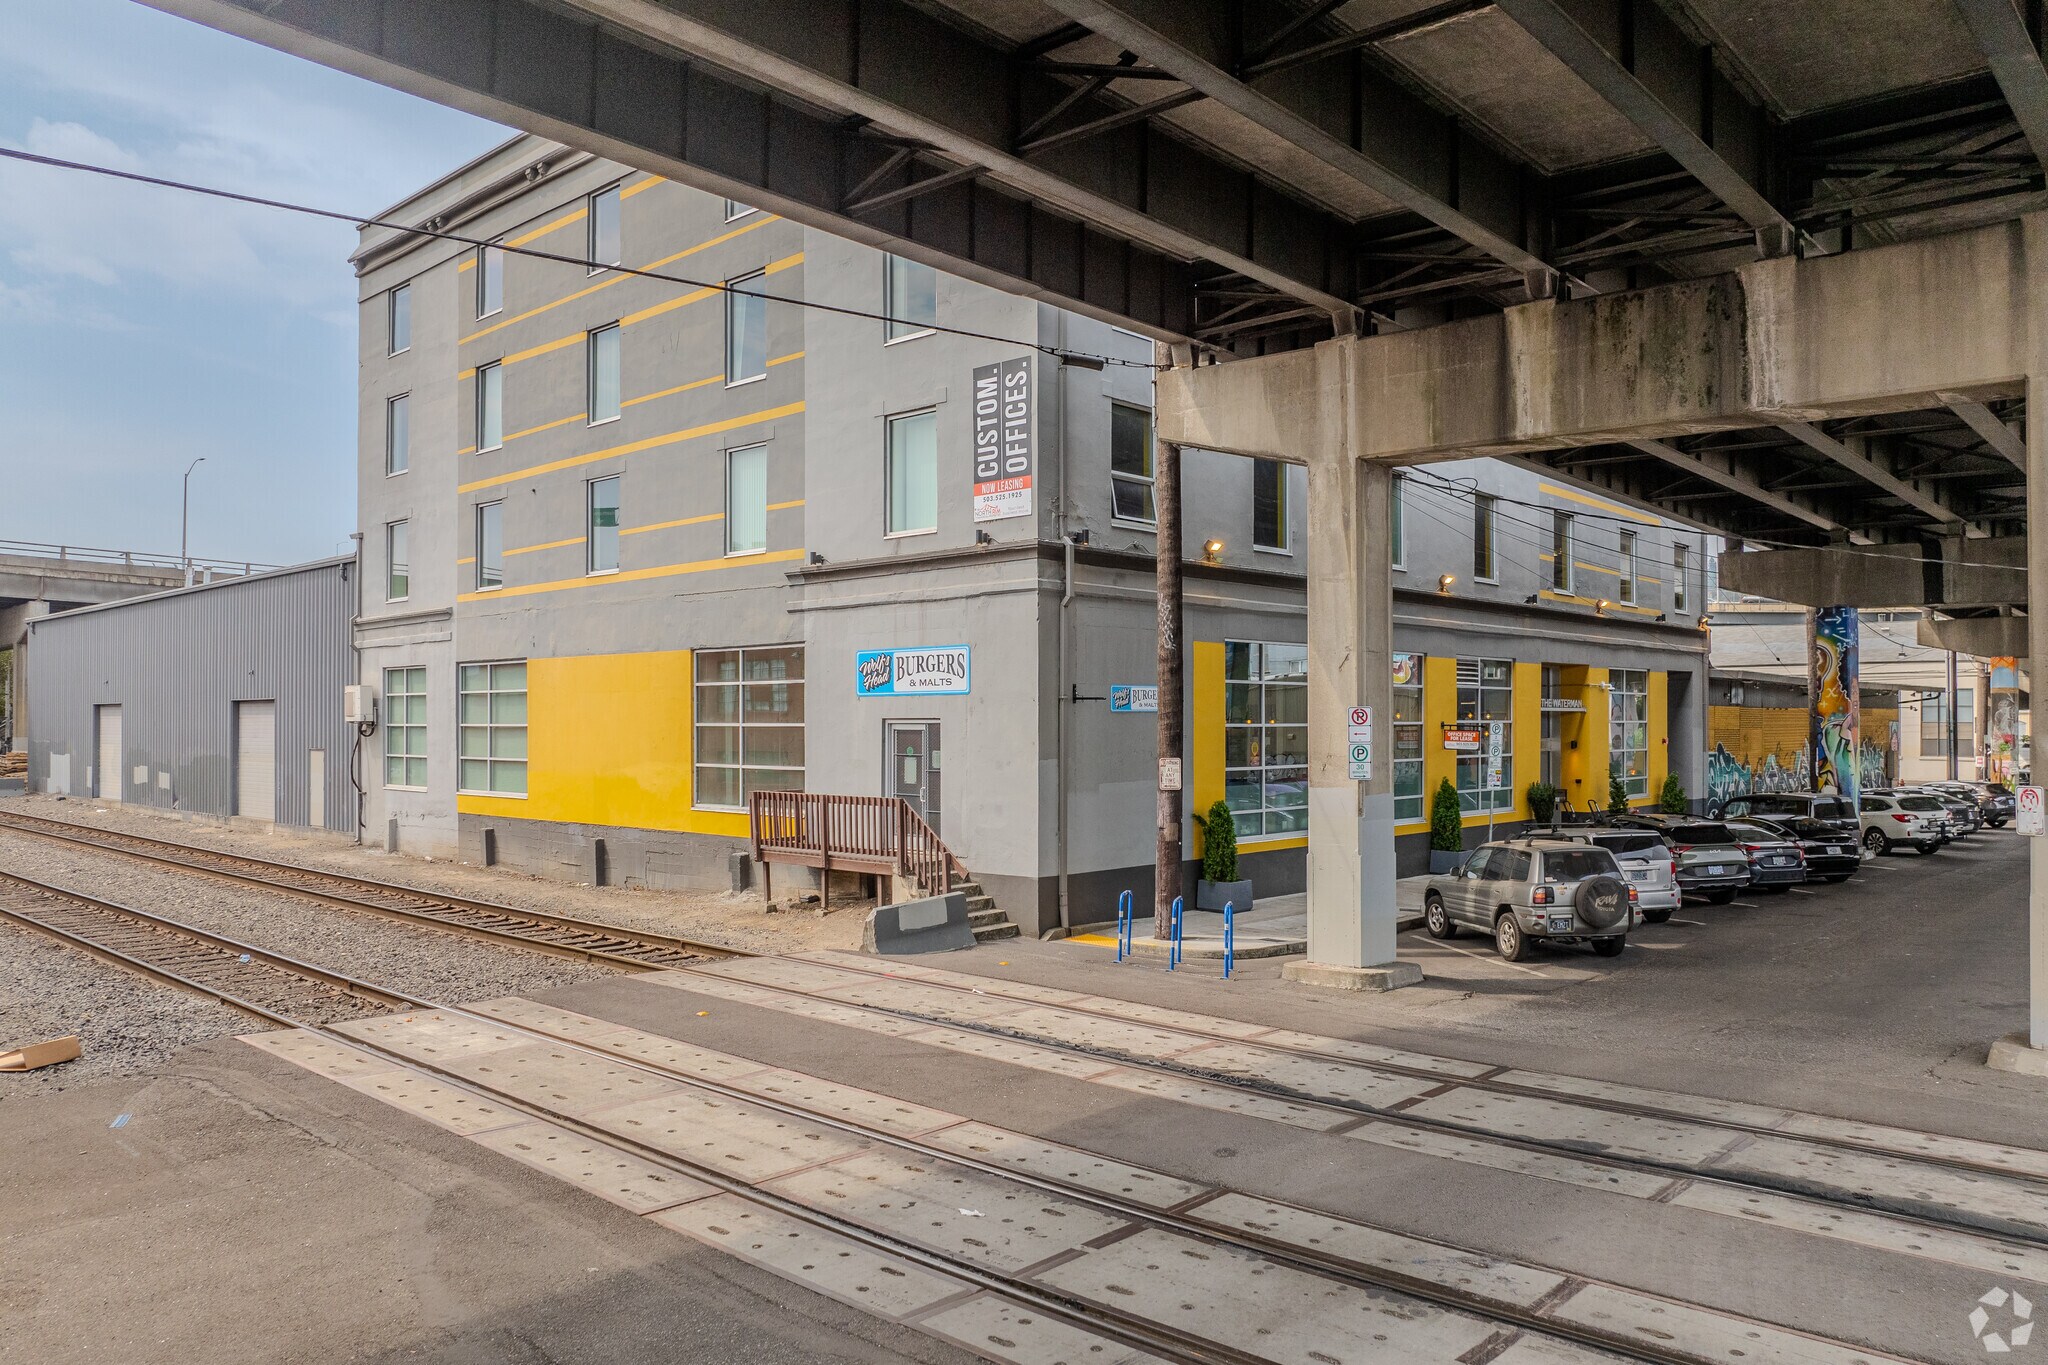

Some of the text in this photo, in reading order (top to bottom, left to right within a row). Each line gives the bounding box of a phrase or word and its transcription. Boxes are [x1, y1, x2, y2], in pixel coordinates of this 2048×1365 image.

[977, 368, 998, 478] CUSTOM.
[1005, 361, 1027, 474] OFFICES.
[981, 479, 1024, 494] NOW LEASING
[896, 653, 965, 682] BURGERS
[863, 666, 891, 692] Head
[909, 678, 953, 687] & MALTS
[1132, 689, 1158, 704] BURGE
[1541, 699, 1583, 708] THE WATERMAN
